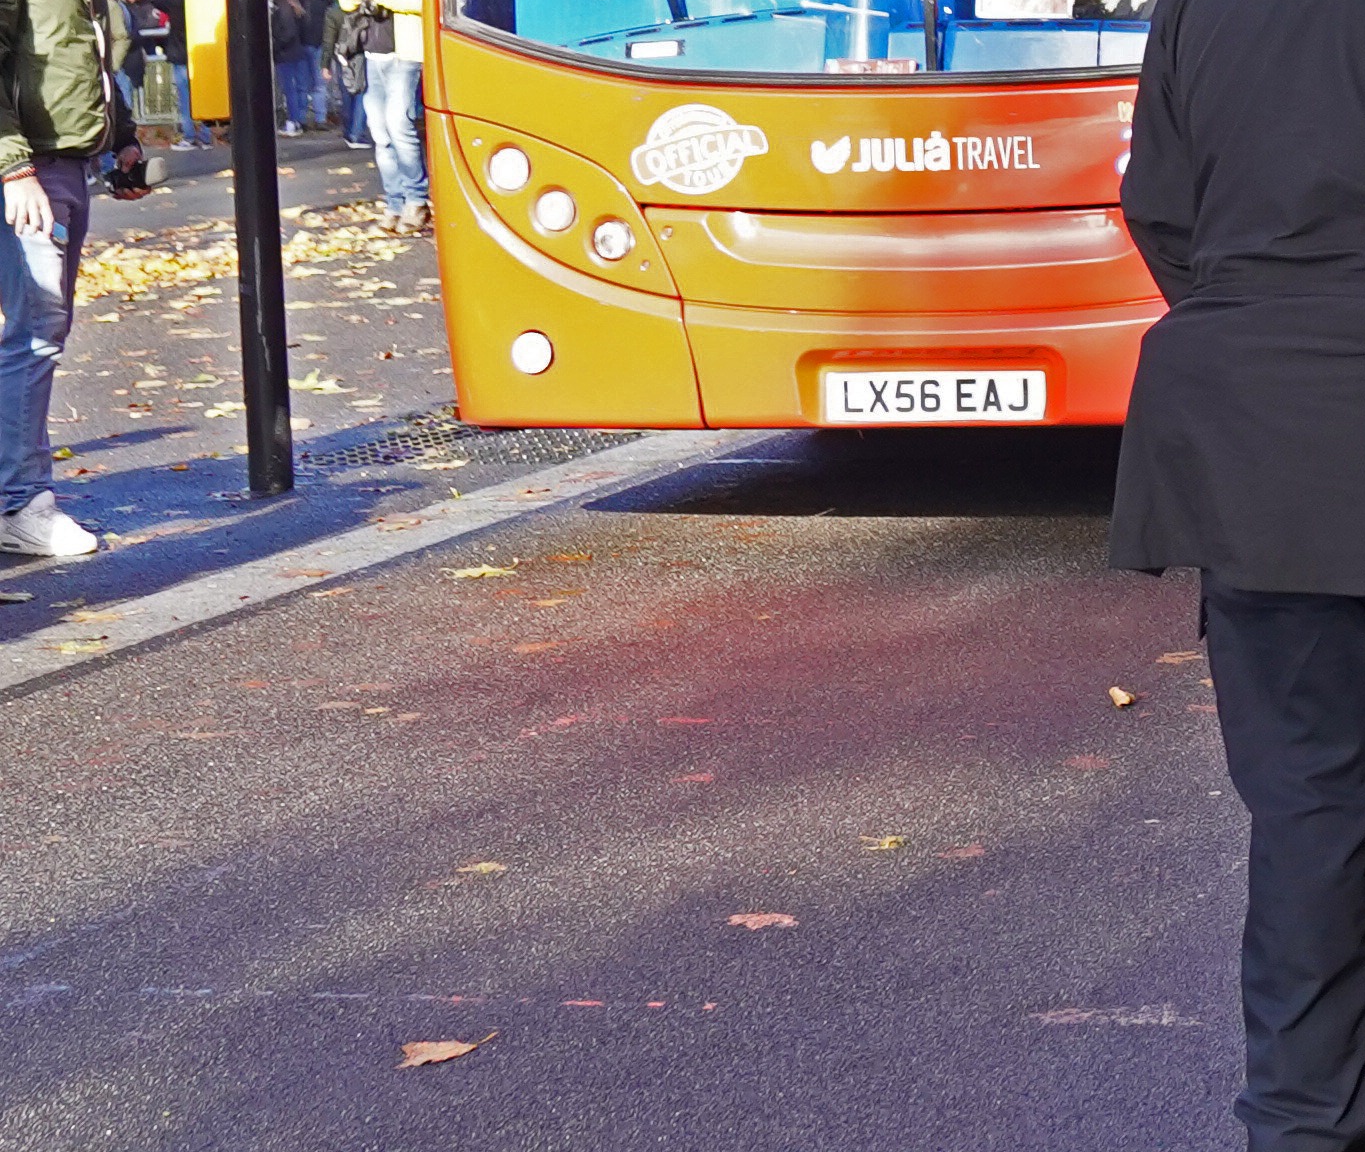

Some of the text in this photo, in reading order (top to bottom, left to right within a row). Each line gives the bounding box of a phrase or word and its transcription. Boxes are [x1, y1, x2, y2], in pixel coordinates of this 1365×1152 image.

[645, 130, 763, 176] OFFICIAL
[952, 136, 1040, 170] TRAVEL
[843, 379, 1029, 413] LX56 EAJ
